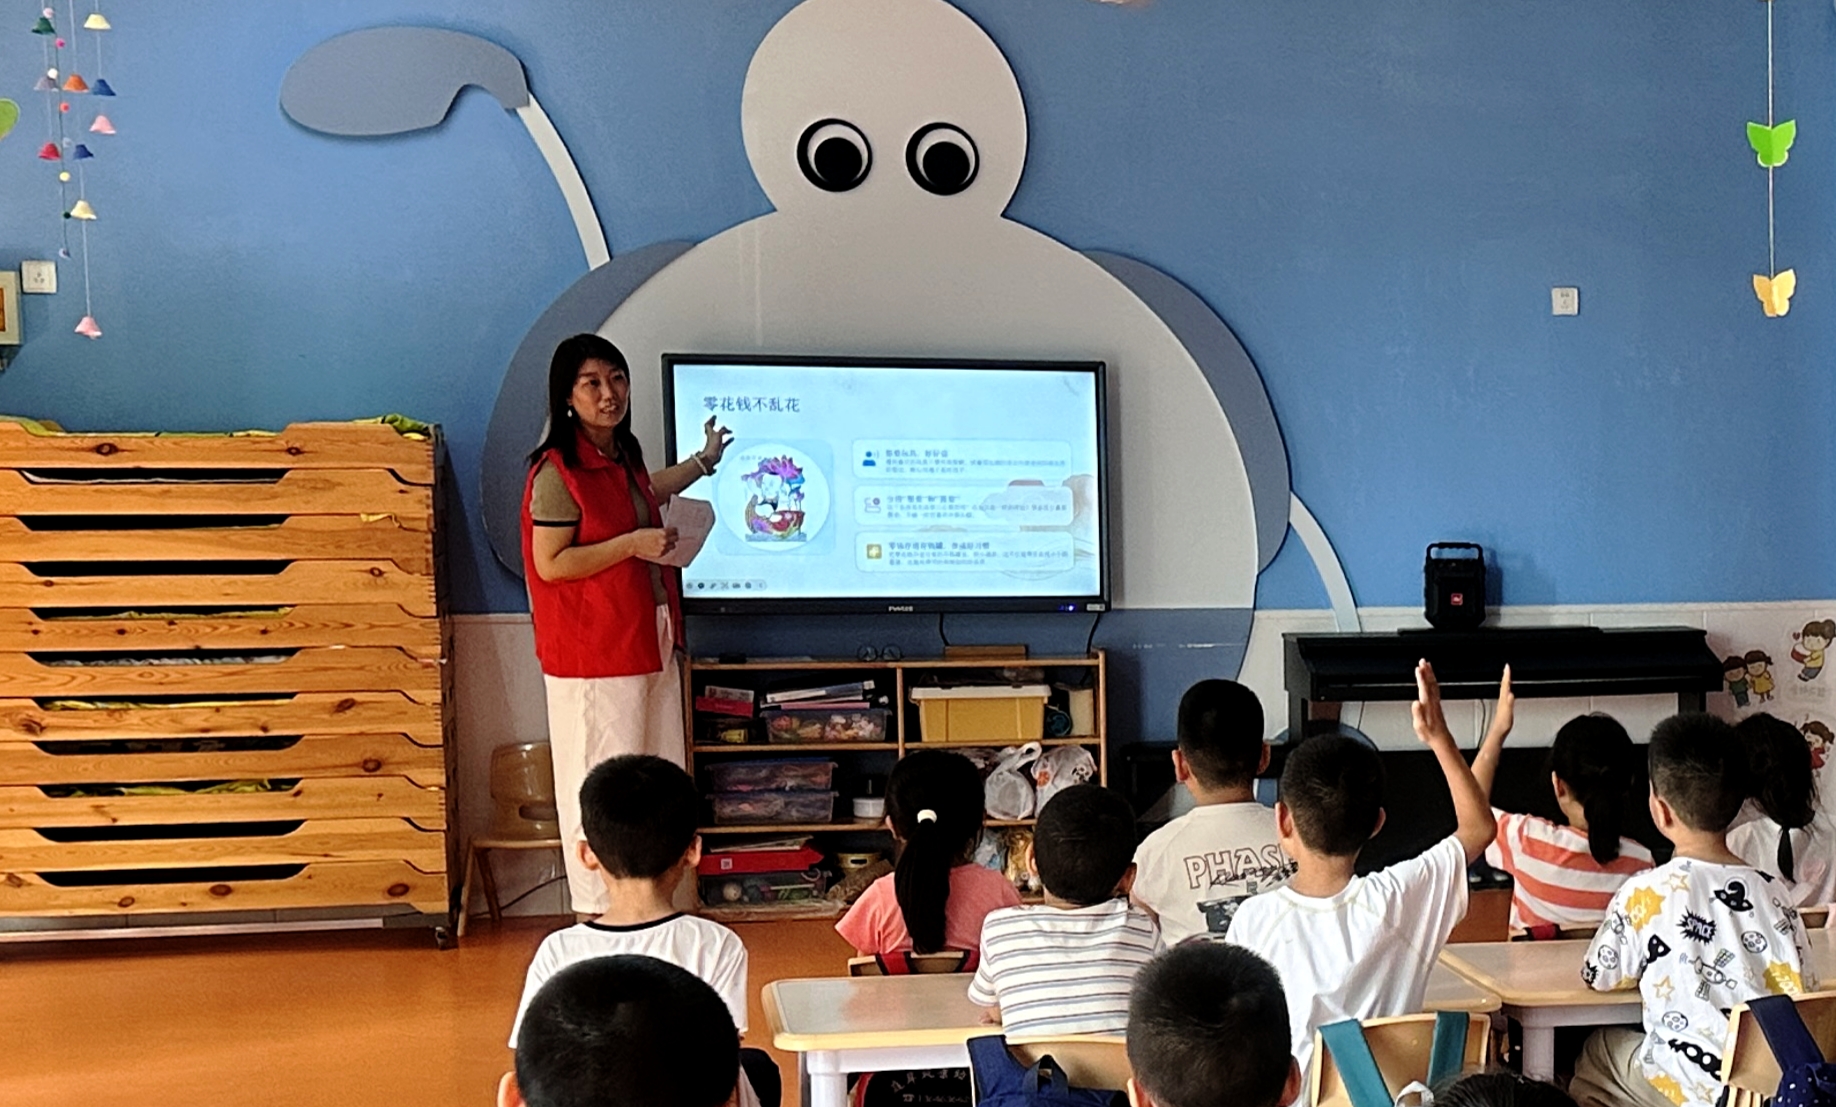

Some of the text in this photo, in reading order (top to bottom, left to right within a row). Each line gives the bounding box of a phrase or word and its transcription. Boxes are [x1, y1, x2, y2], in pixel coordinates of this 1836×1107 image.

[703, 396, 800, 412] 零花钱不乱花
[1183, 843, 1284, 890] PHAS
